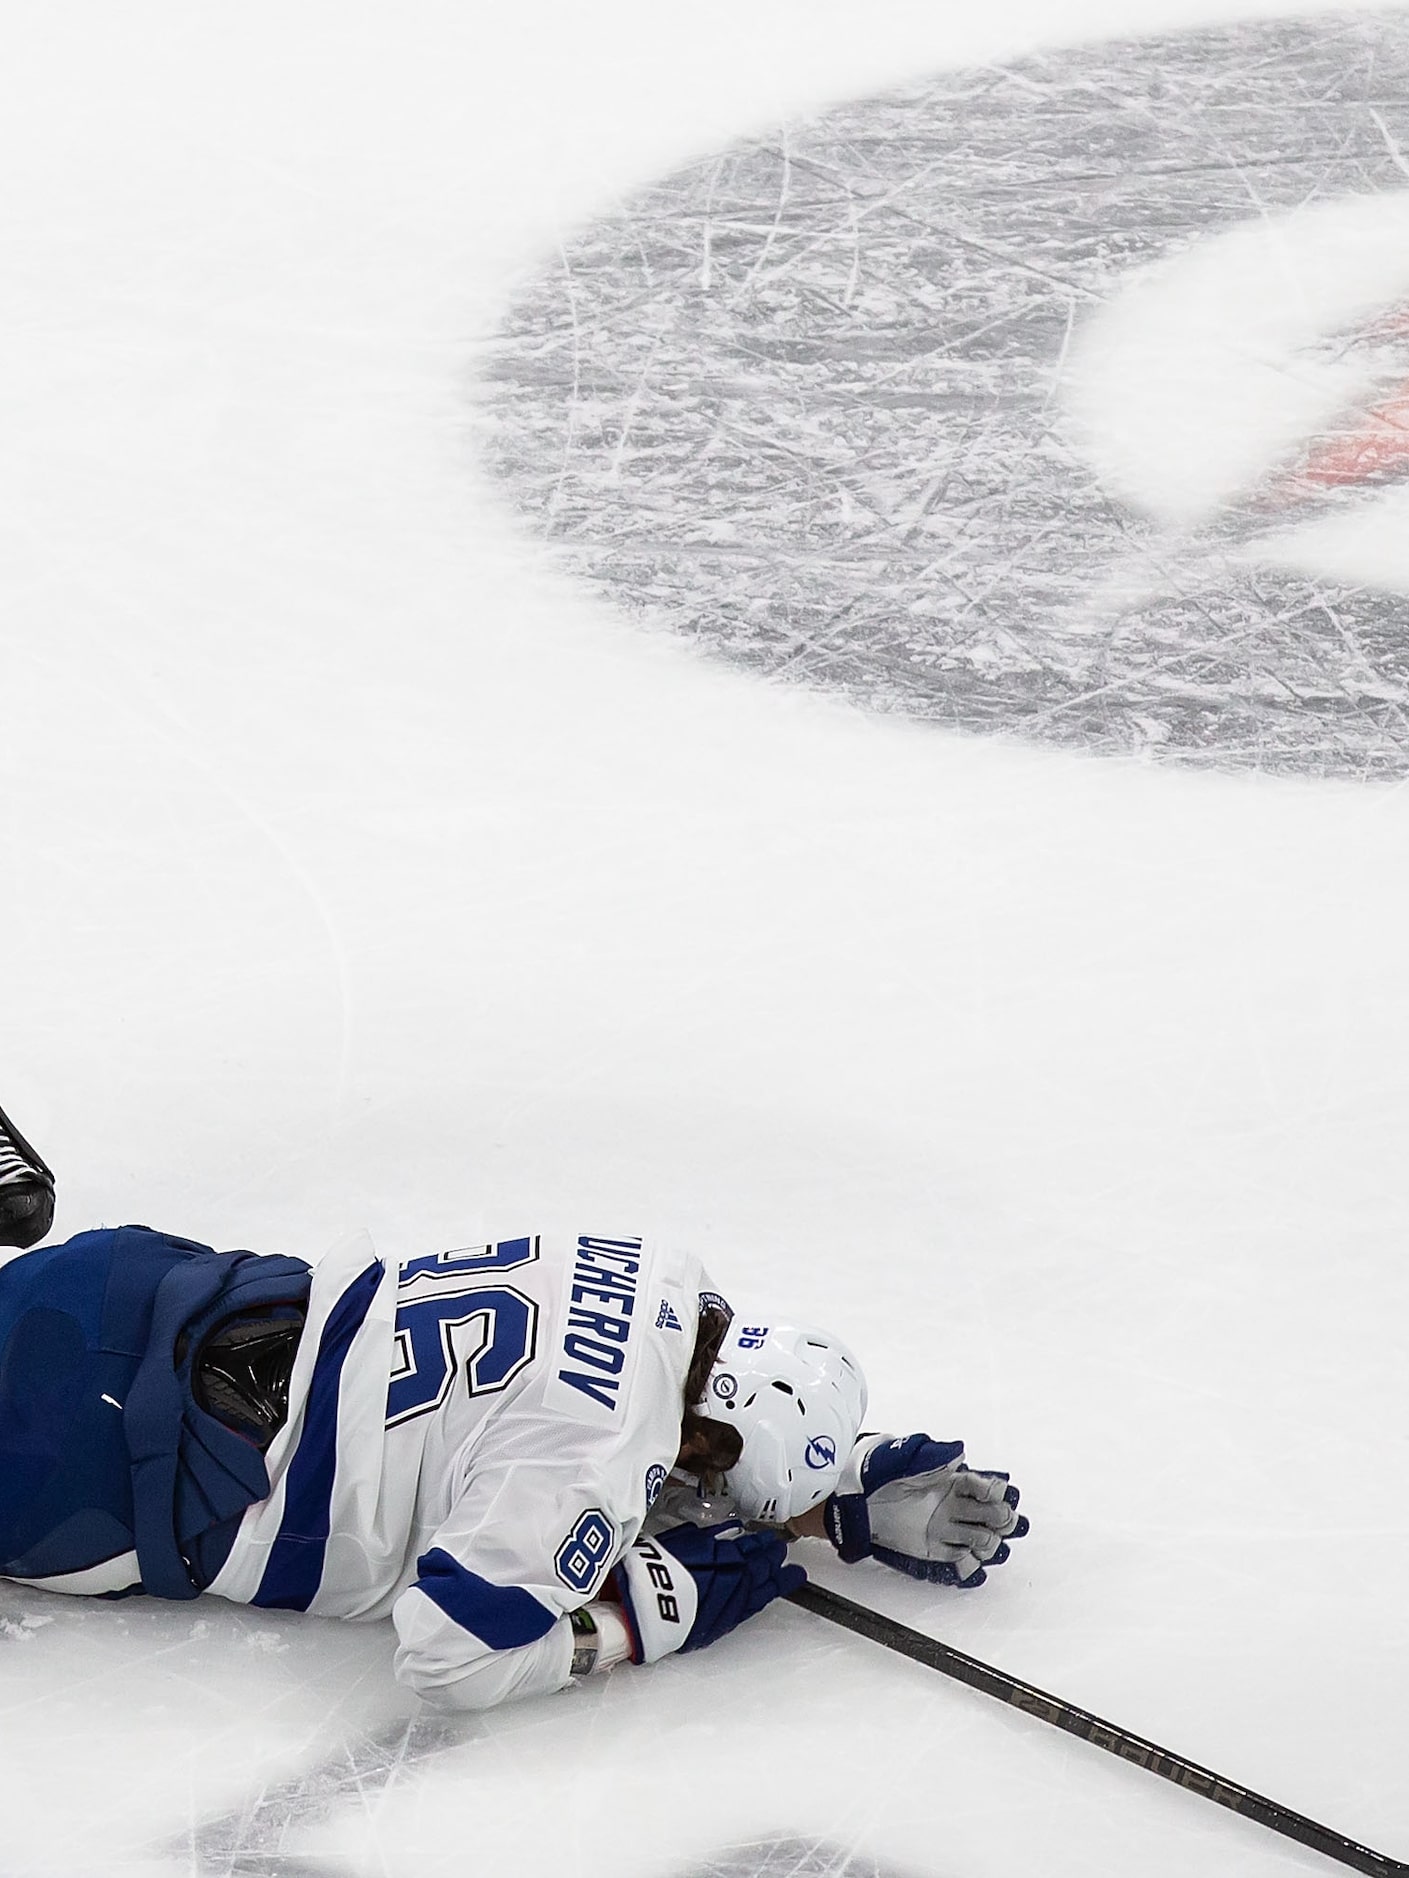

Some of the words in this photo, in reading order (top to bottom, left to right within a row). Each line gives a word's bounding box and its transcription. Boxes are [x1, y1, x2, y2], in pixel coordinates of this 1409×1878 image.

[558, 1234, 643, 1411] UCHEROV
[554, 1508, 615, 1595] 8
[636, 1537, 681, 1624] BAU
